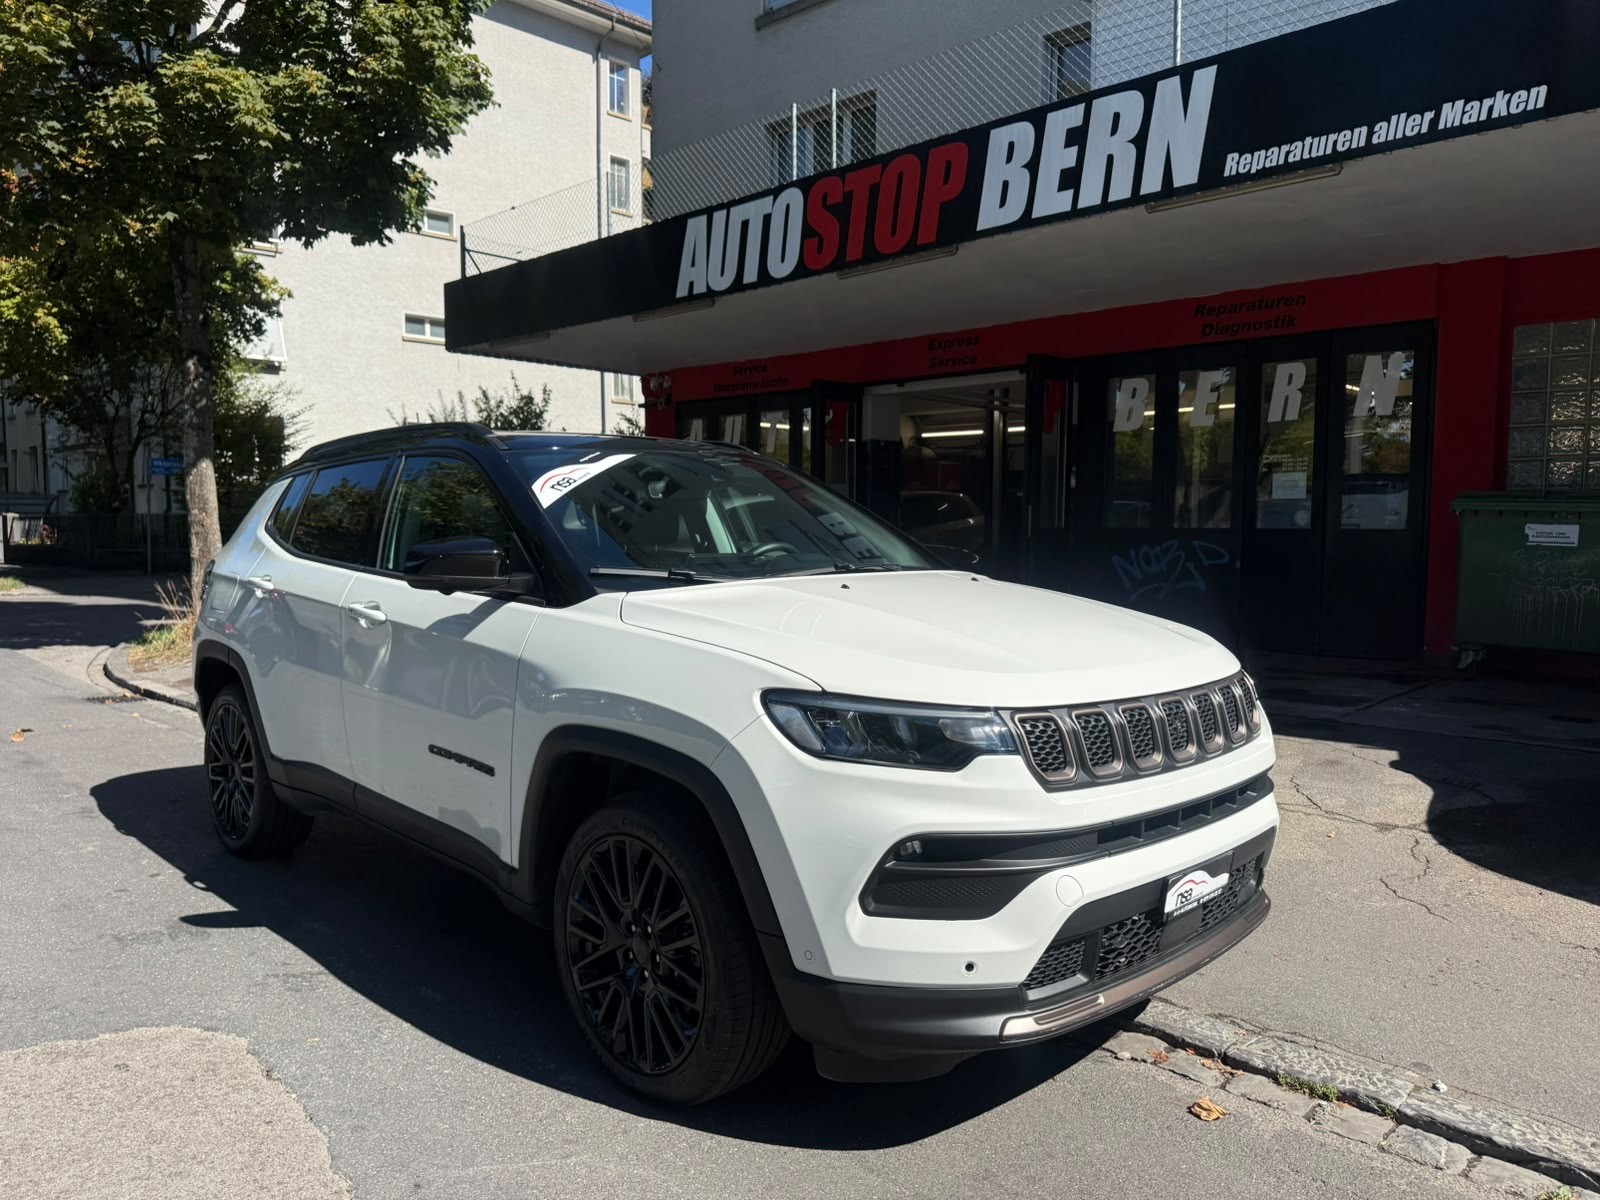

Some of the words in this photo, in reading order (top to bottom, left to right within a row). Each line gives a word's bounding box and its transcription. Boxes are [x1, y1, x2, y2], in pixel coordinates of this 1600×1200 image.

[1223, 125, 1368, 178] Reparaturen
[1371, 110, 1435, 145] aller
[1437, 83, 1549, 130] Marken
[676, 141, 969, 299] AUTOSTOP
[976, 64, 1219, 232] BERN
[1193, 295, 1308, 320] Reparaturen
[1201, 314, 1297, 337] Diagnostik
[928, 335, 980, 352] Express
[929, 353, 977, 369] Service
